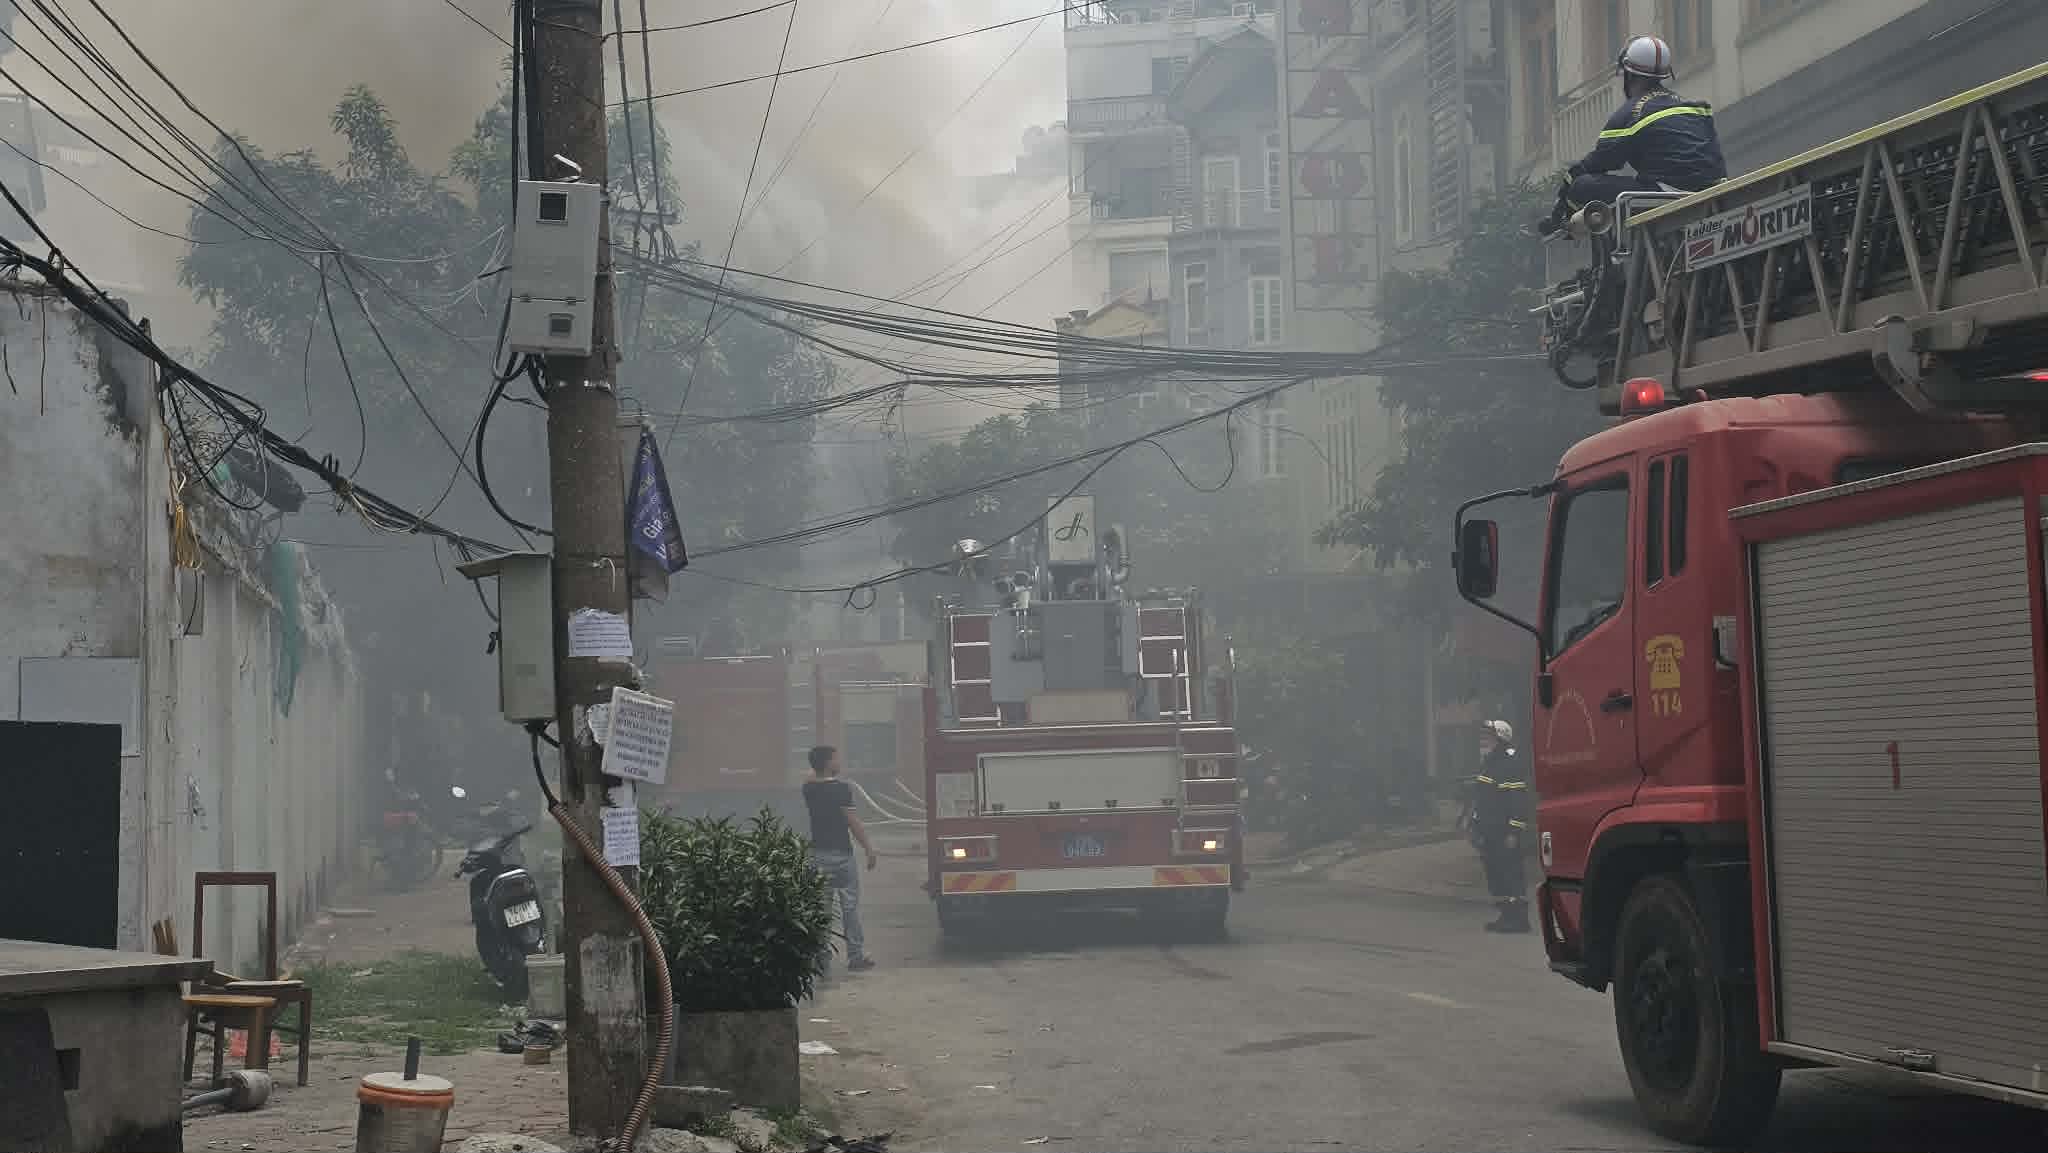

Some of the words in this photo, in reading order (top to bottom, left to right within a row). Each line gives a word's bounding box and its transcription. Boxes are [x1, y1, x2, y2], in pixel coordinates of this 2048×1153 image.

[1720, 199, 1809, 250] MORITA
[1651, 691, 1682, 718] 114
[1887, 740, 1901, 788] 1
